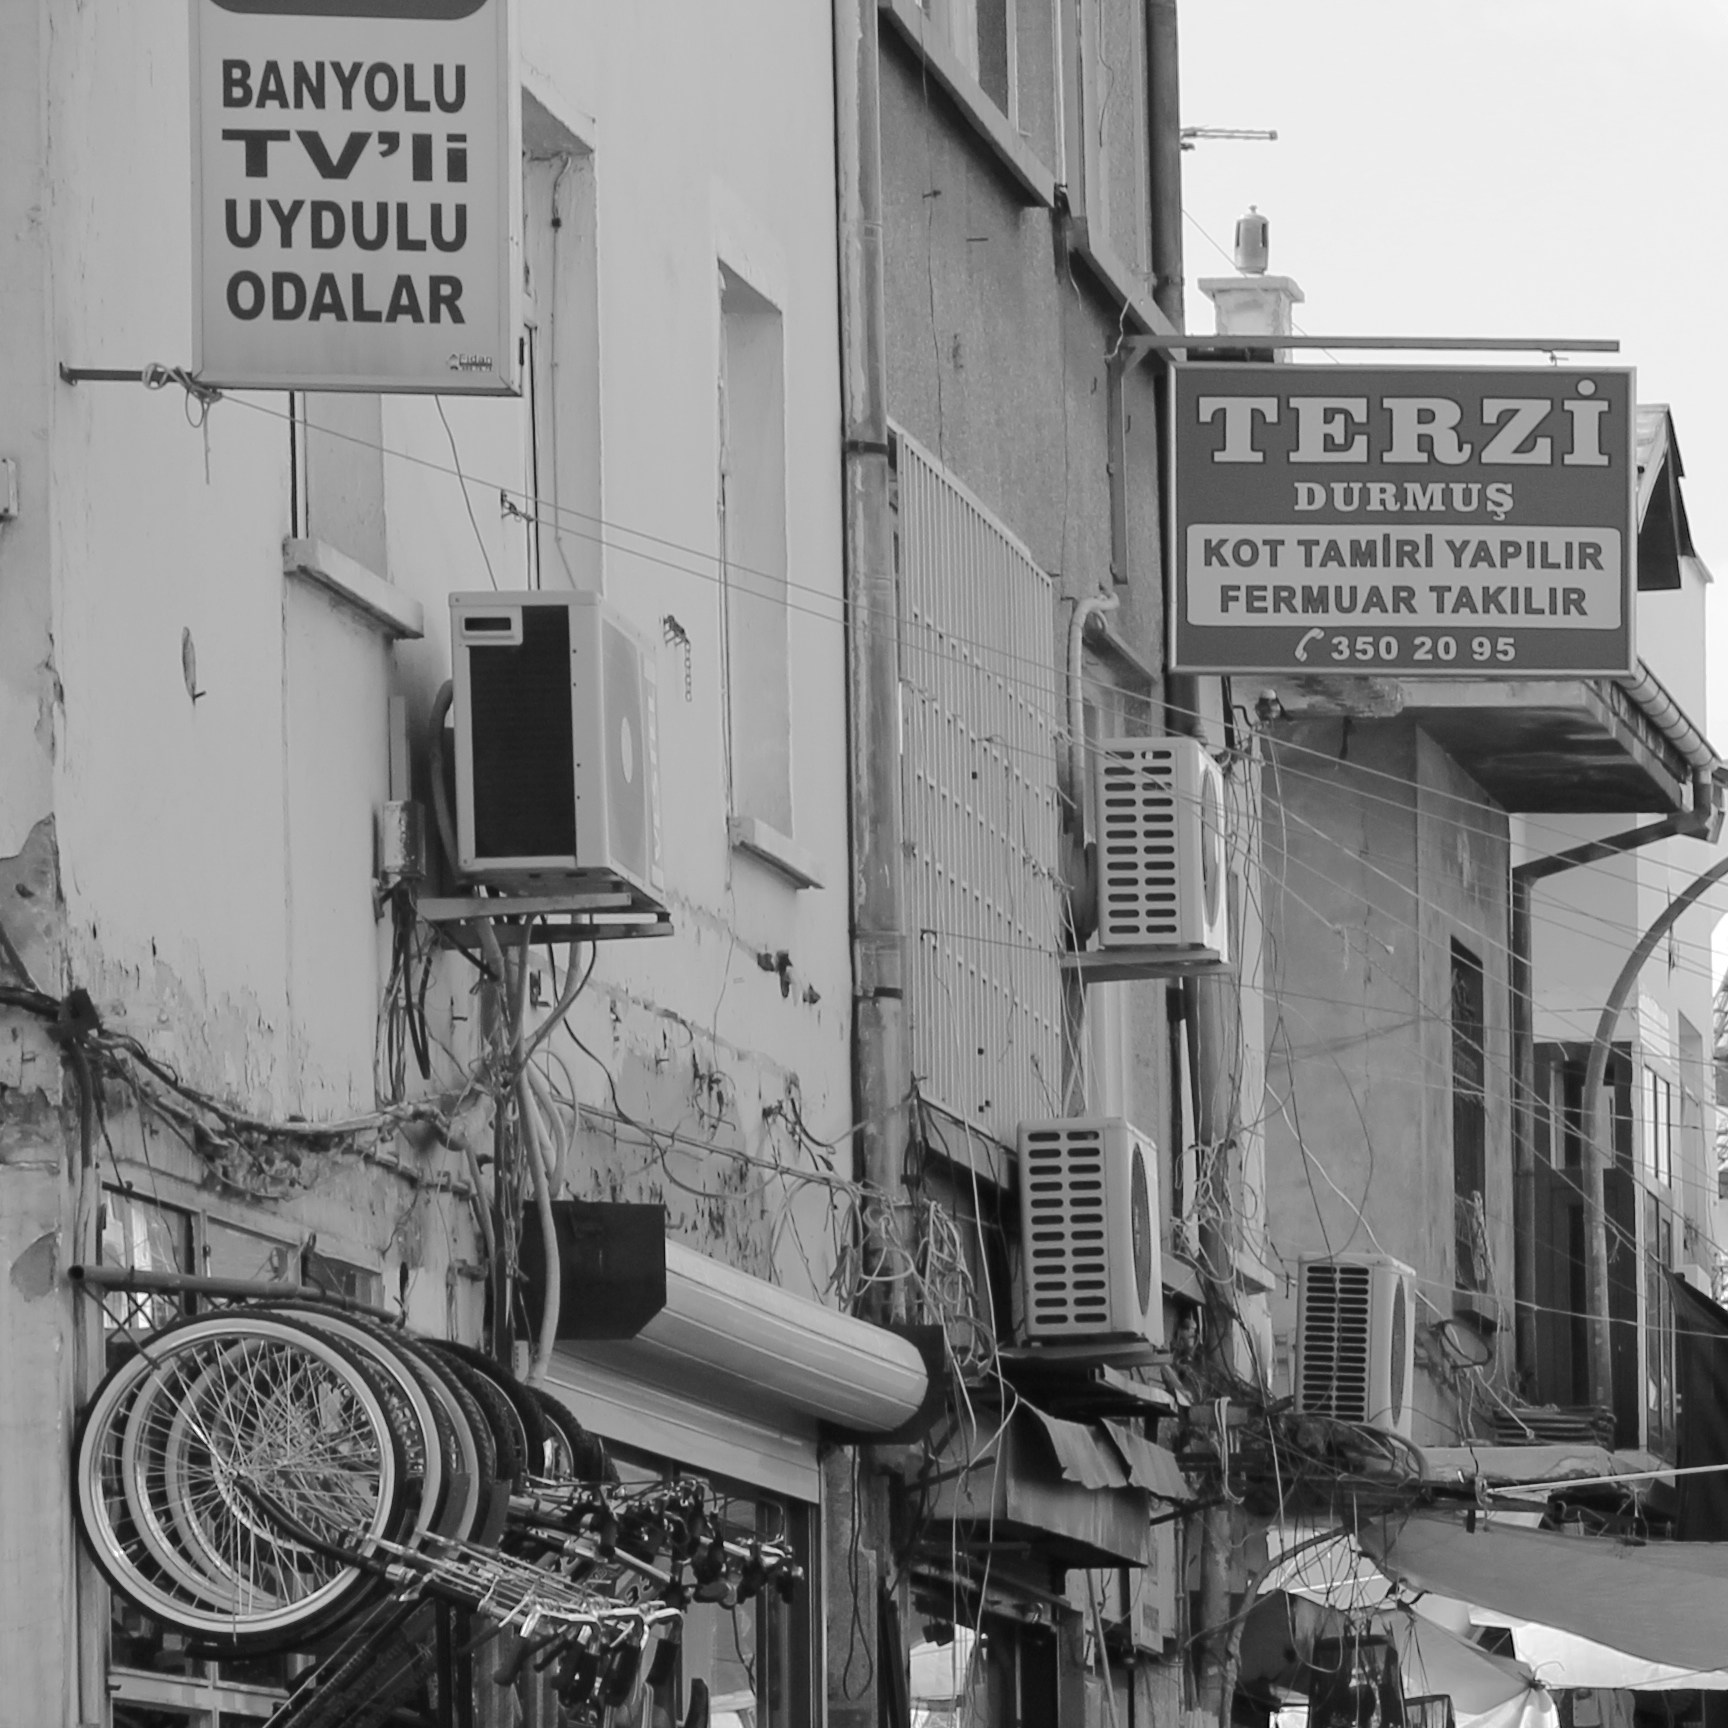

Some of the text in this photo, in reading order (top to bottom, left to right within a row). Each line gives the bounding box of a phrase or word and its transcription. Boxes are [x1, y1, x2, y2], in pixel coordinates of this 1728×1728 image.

[222, 59, 467, 113] BANYOLU
[225, 198, 467, 252] UYDULU
[226, 271, 466, 325] ODALAR
[1198, 380, 1611, 466] TERZİ
[1293, 481, 1515, 521] DURMUŞ
[1204, 533, 1604, 571] KOT TAMİRİ YAPILIR
[1220, 585, 1587, 616] FERMUAR TAKILIR
[1331, 635, 1516, 661] 350 20 95
